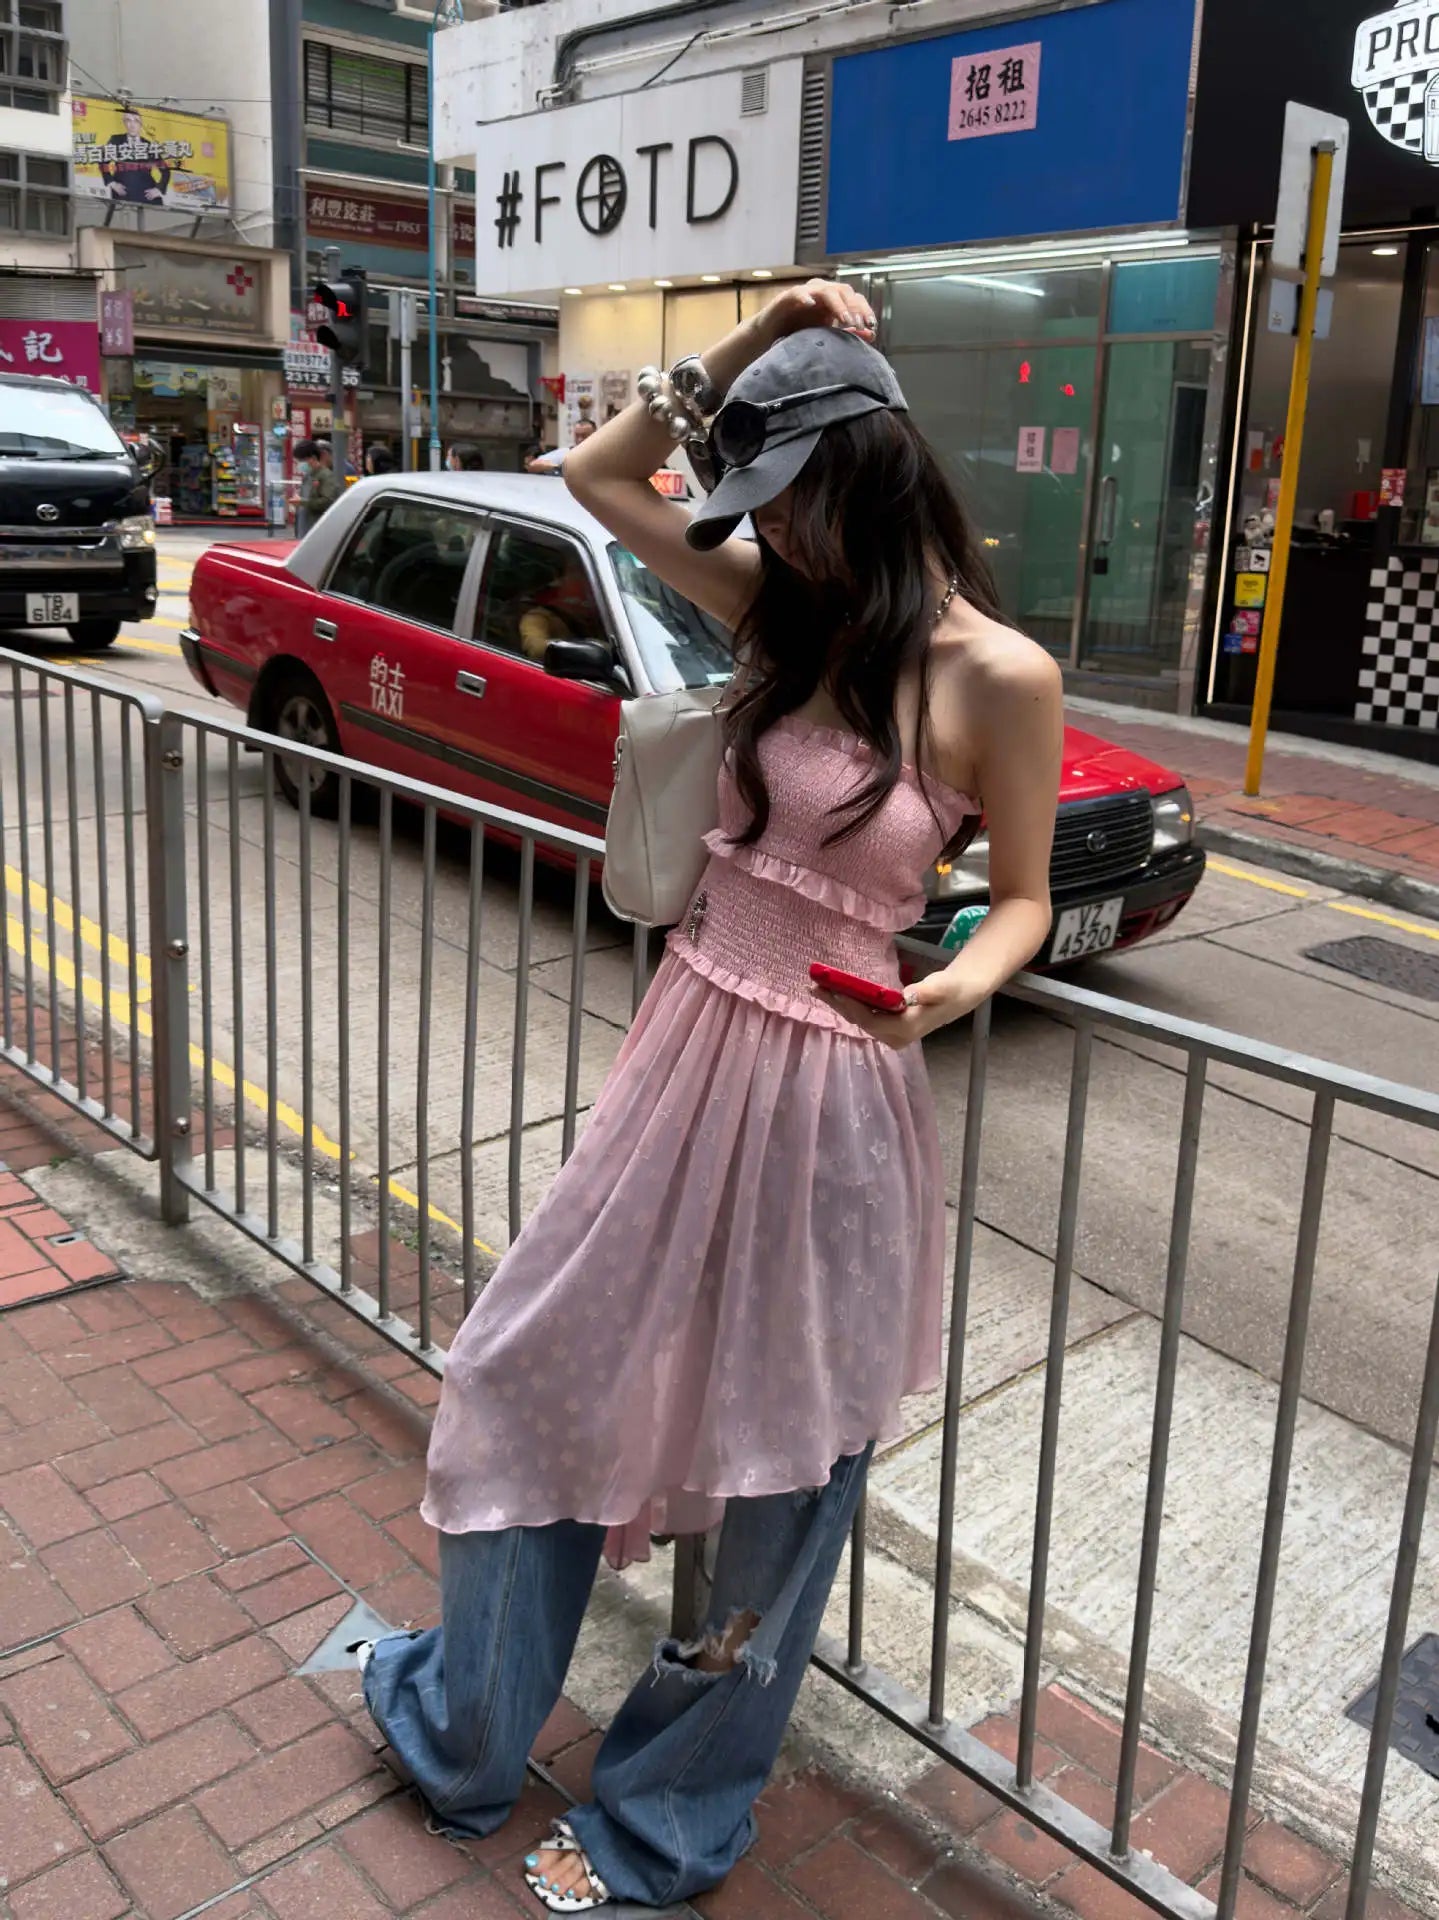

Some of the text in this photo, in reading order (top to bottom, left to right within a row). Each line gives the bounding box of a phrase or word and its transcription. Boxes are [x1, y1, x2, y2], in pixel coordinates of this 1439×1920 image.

[964, 57, 1025, 102] 招租
[959, 99, 1026, 129] 2645 8222
[42, 595, 63, 609] TB
[370, 655, 406, 691] 的士
[369, 681, 404, 720] TAXI
[1080, 904, 1104, 929] VZ
[1058, 924, 1112, 958] 4520
